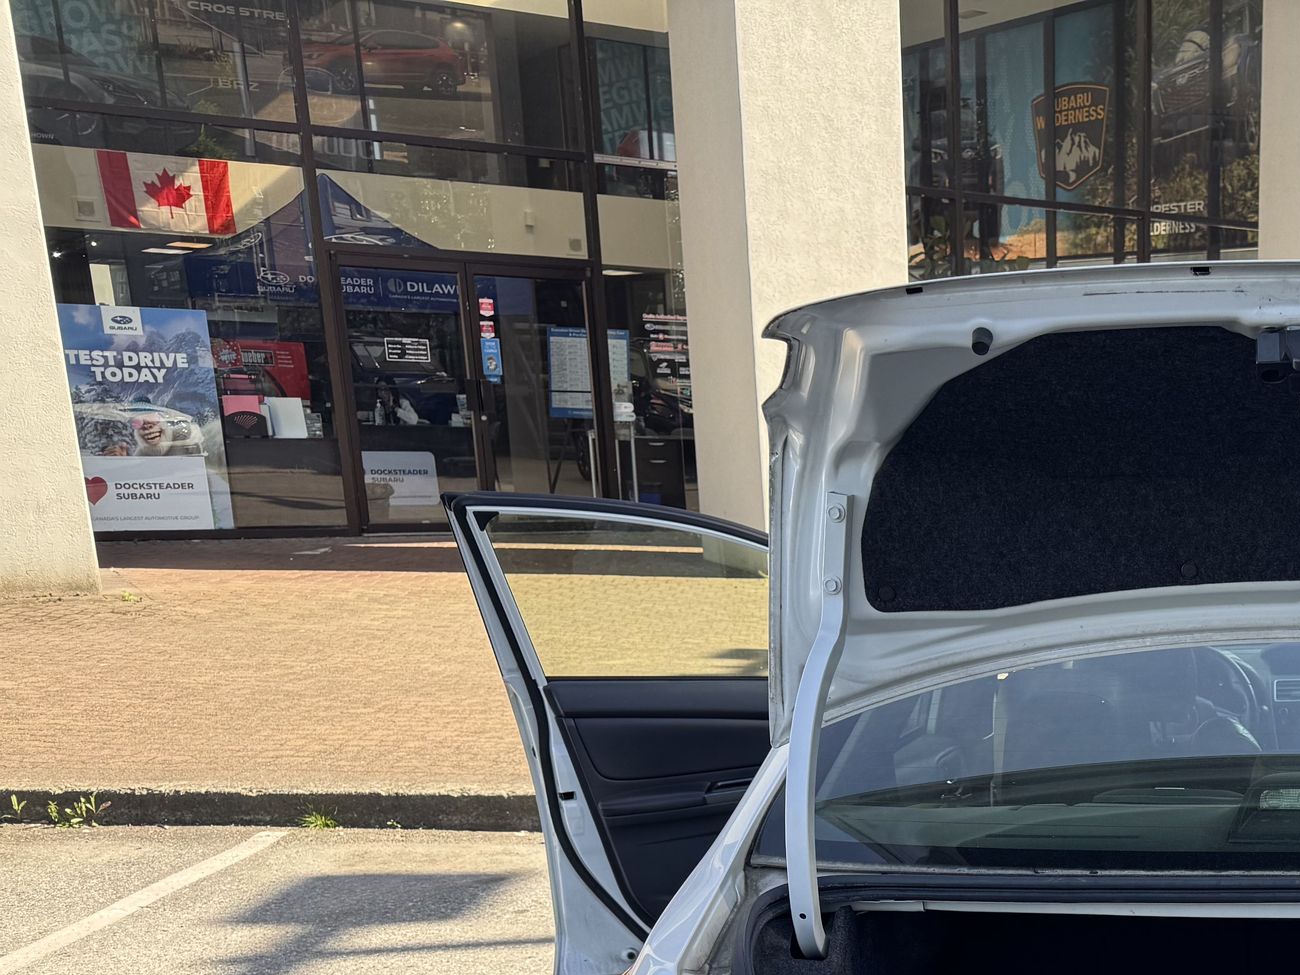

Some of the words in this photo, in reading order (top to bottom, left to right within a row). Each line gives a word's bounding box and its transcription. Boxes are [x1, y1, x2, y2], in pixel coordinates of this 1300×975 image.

[187, 1, 286, 21] CROSSTRE
[1055, 92, 1092, 111] UBARU
[1036, 105, 1105, 130] WDERNESS
[341, 284, 375, 294] UBARU
[406, 281, 459, 295] DILAW
[65, 350, 117, 366] TEST
[122, 351, 189, 368] DRIVE
[91, 366, 167, 383] TODAY
[114, 482, 195, 490] DOCKSTEADER
[116, 492, 161, 500] SUBARU
